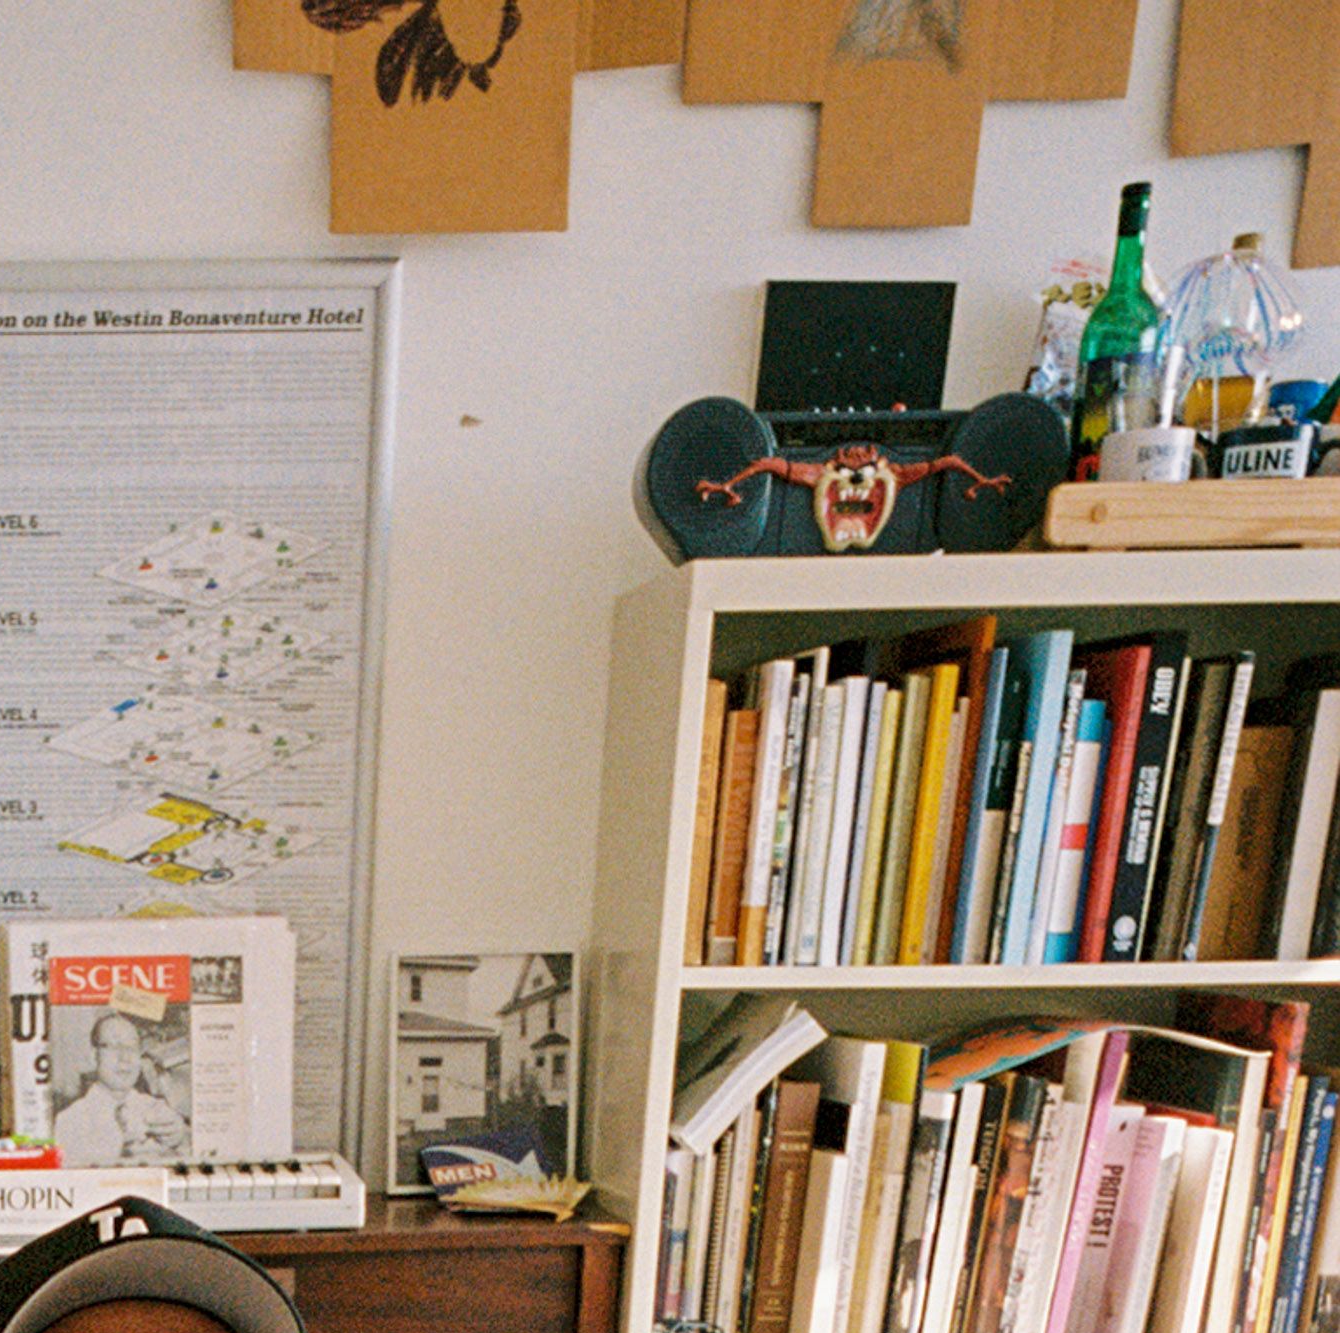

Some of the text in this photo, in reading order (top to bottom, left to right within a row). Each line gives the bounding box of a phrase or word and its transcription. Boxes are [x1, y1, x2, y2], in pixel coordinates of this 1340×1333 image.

[22, 314, 48, 328] on
[54, 311, 87, 327] the
[93, 310, 163, 327] Westin
[169, 309, 302, 326] Bonaventure
[307, 308, 364, 325] Hotel
[1226, 448, 1295, 474] ULINE
[29, 515, 38, 529] 6
[29, 612, 38, 626] 5
[1151, 667, 1176, 715] OBEY
[30, 708, 38, 721] 4
[29, 801, 38, 815] 3
[30, 891, 38, 905] 2
[64, 964, 176, 991] SCENE
[436, 1164, 493, 1184] MEN
[1088, 1162, 1126, 1239] PROTEST
